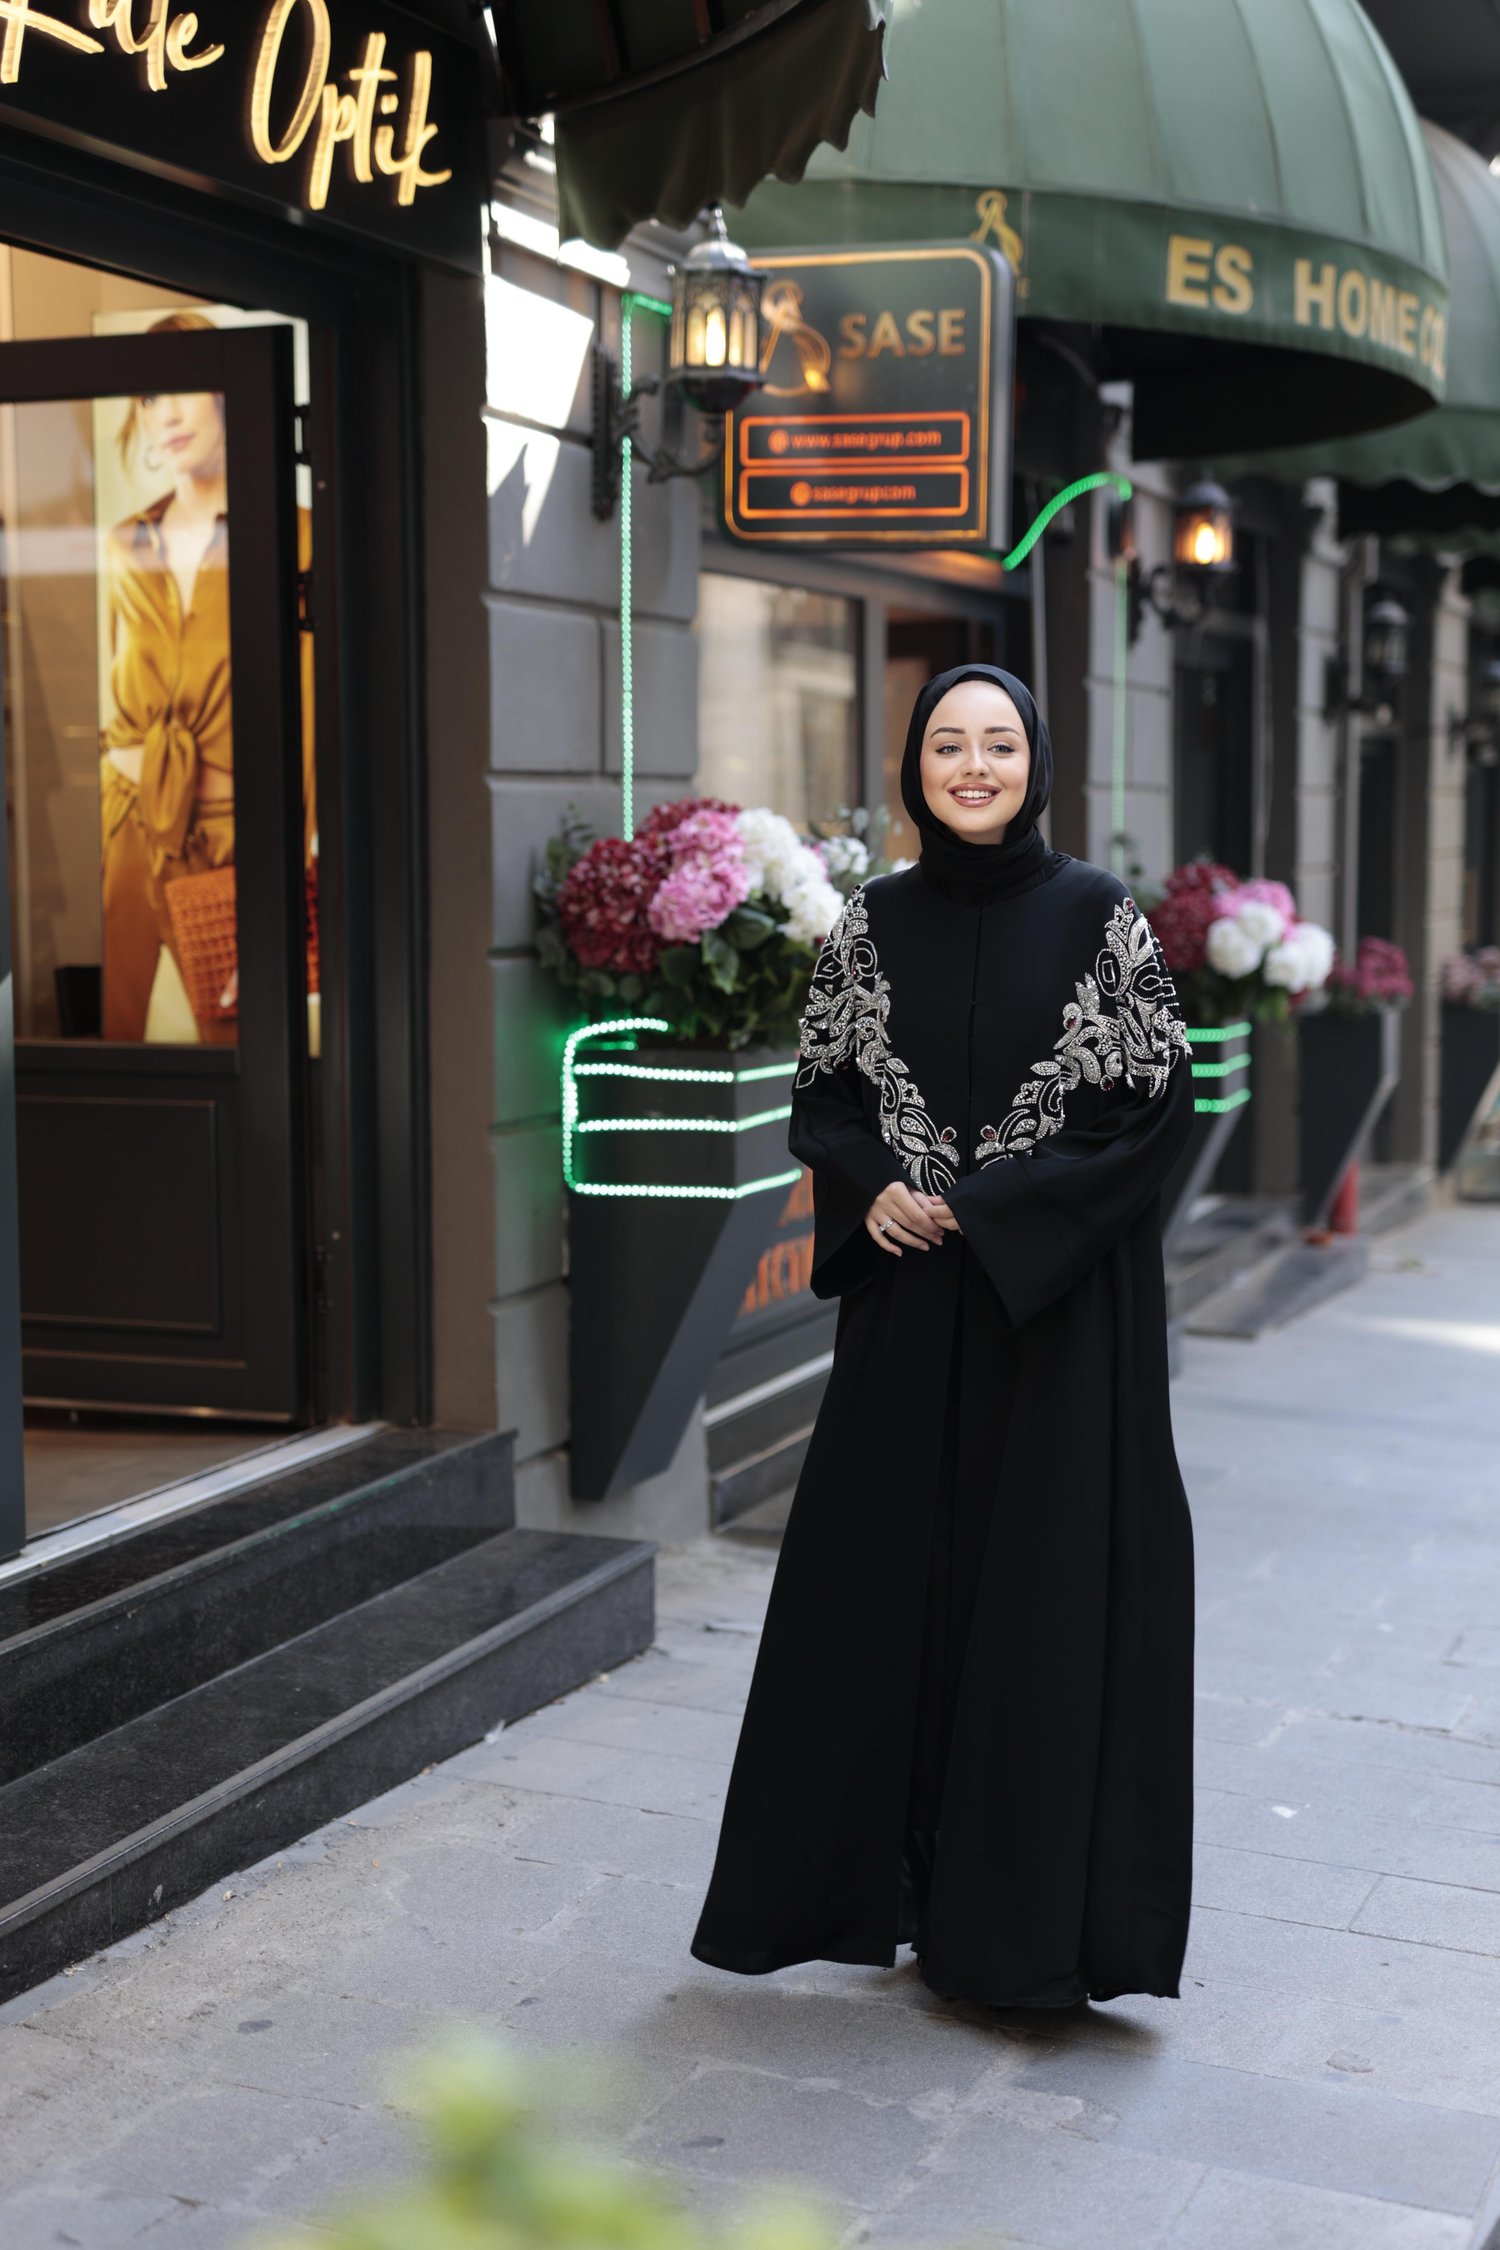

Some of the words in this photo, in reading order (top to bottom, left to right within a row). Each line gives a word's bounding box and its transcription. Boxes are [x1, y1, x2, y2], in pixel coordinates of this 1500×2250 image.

[251, 0, 452, 210] Optik
[838, 308, 967, 361] SASE
[1166, 234, 1254, 315] ES
[1294, 258, 1419, 357] HOME
